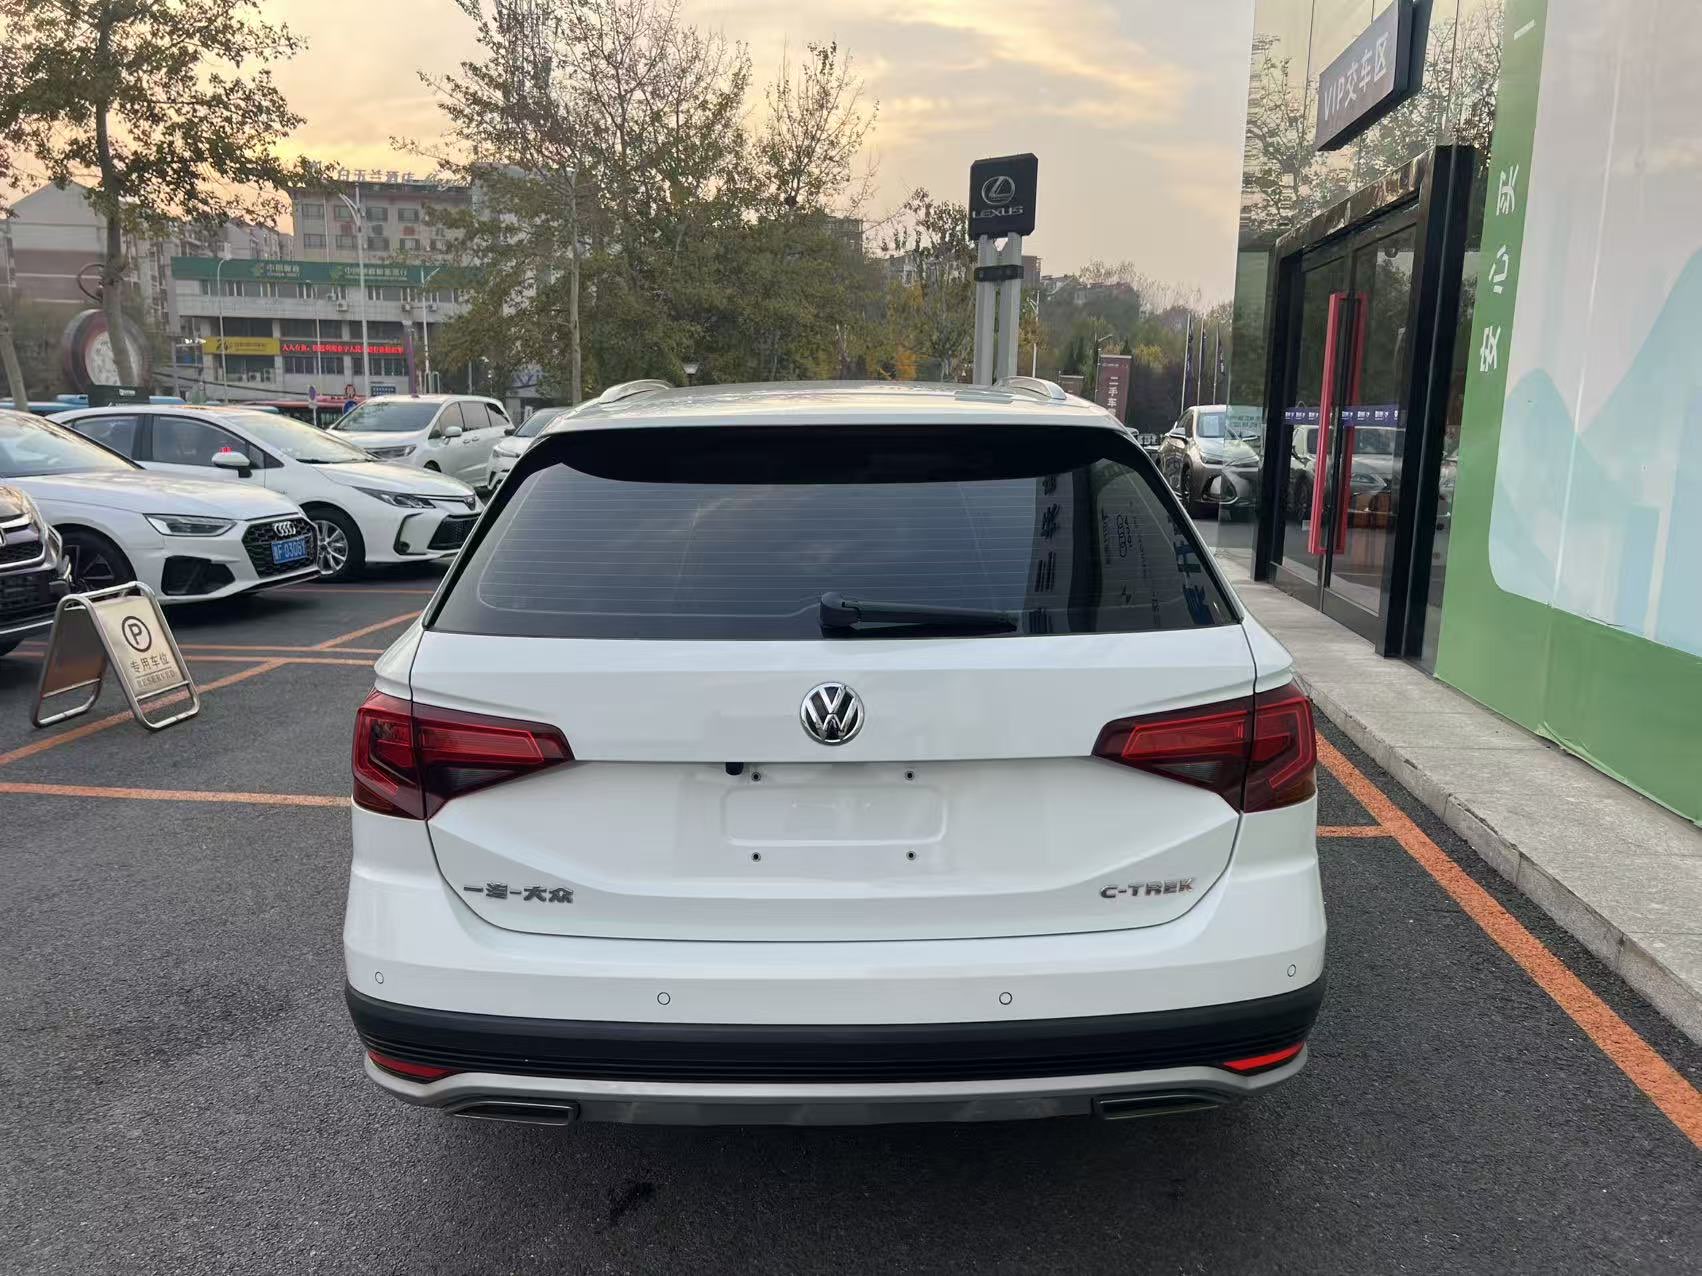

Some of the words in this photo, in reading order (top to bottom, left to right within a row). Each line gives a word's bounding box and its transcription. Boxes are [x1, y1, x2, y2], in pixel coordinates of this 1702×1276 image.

[1323, 31, 1389, 121] VIP交车区
[972, 205, 1024, 219] LEXUS
[129, 651, 170, 674] 专用车位
[1100, 878, 1195, 899] C-TREK
